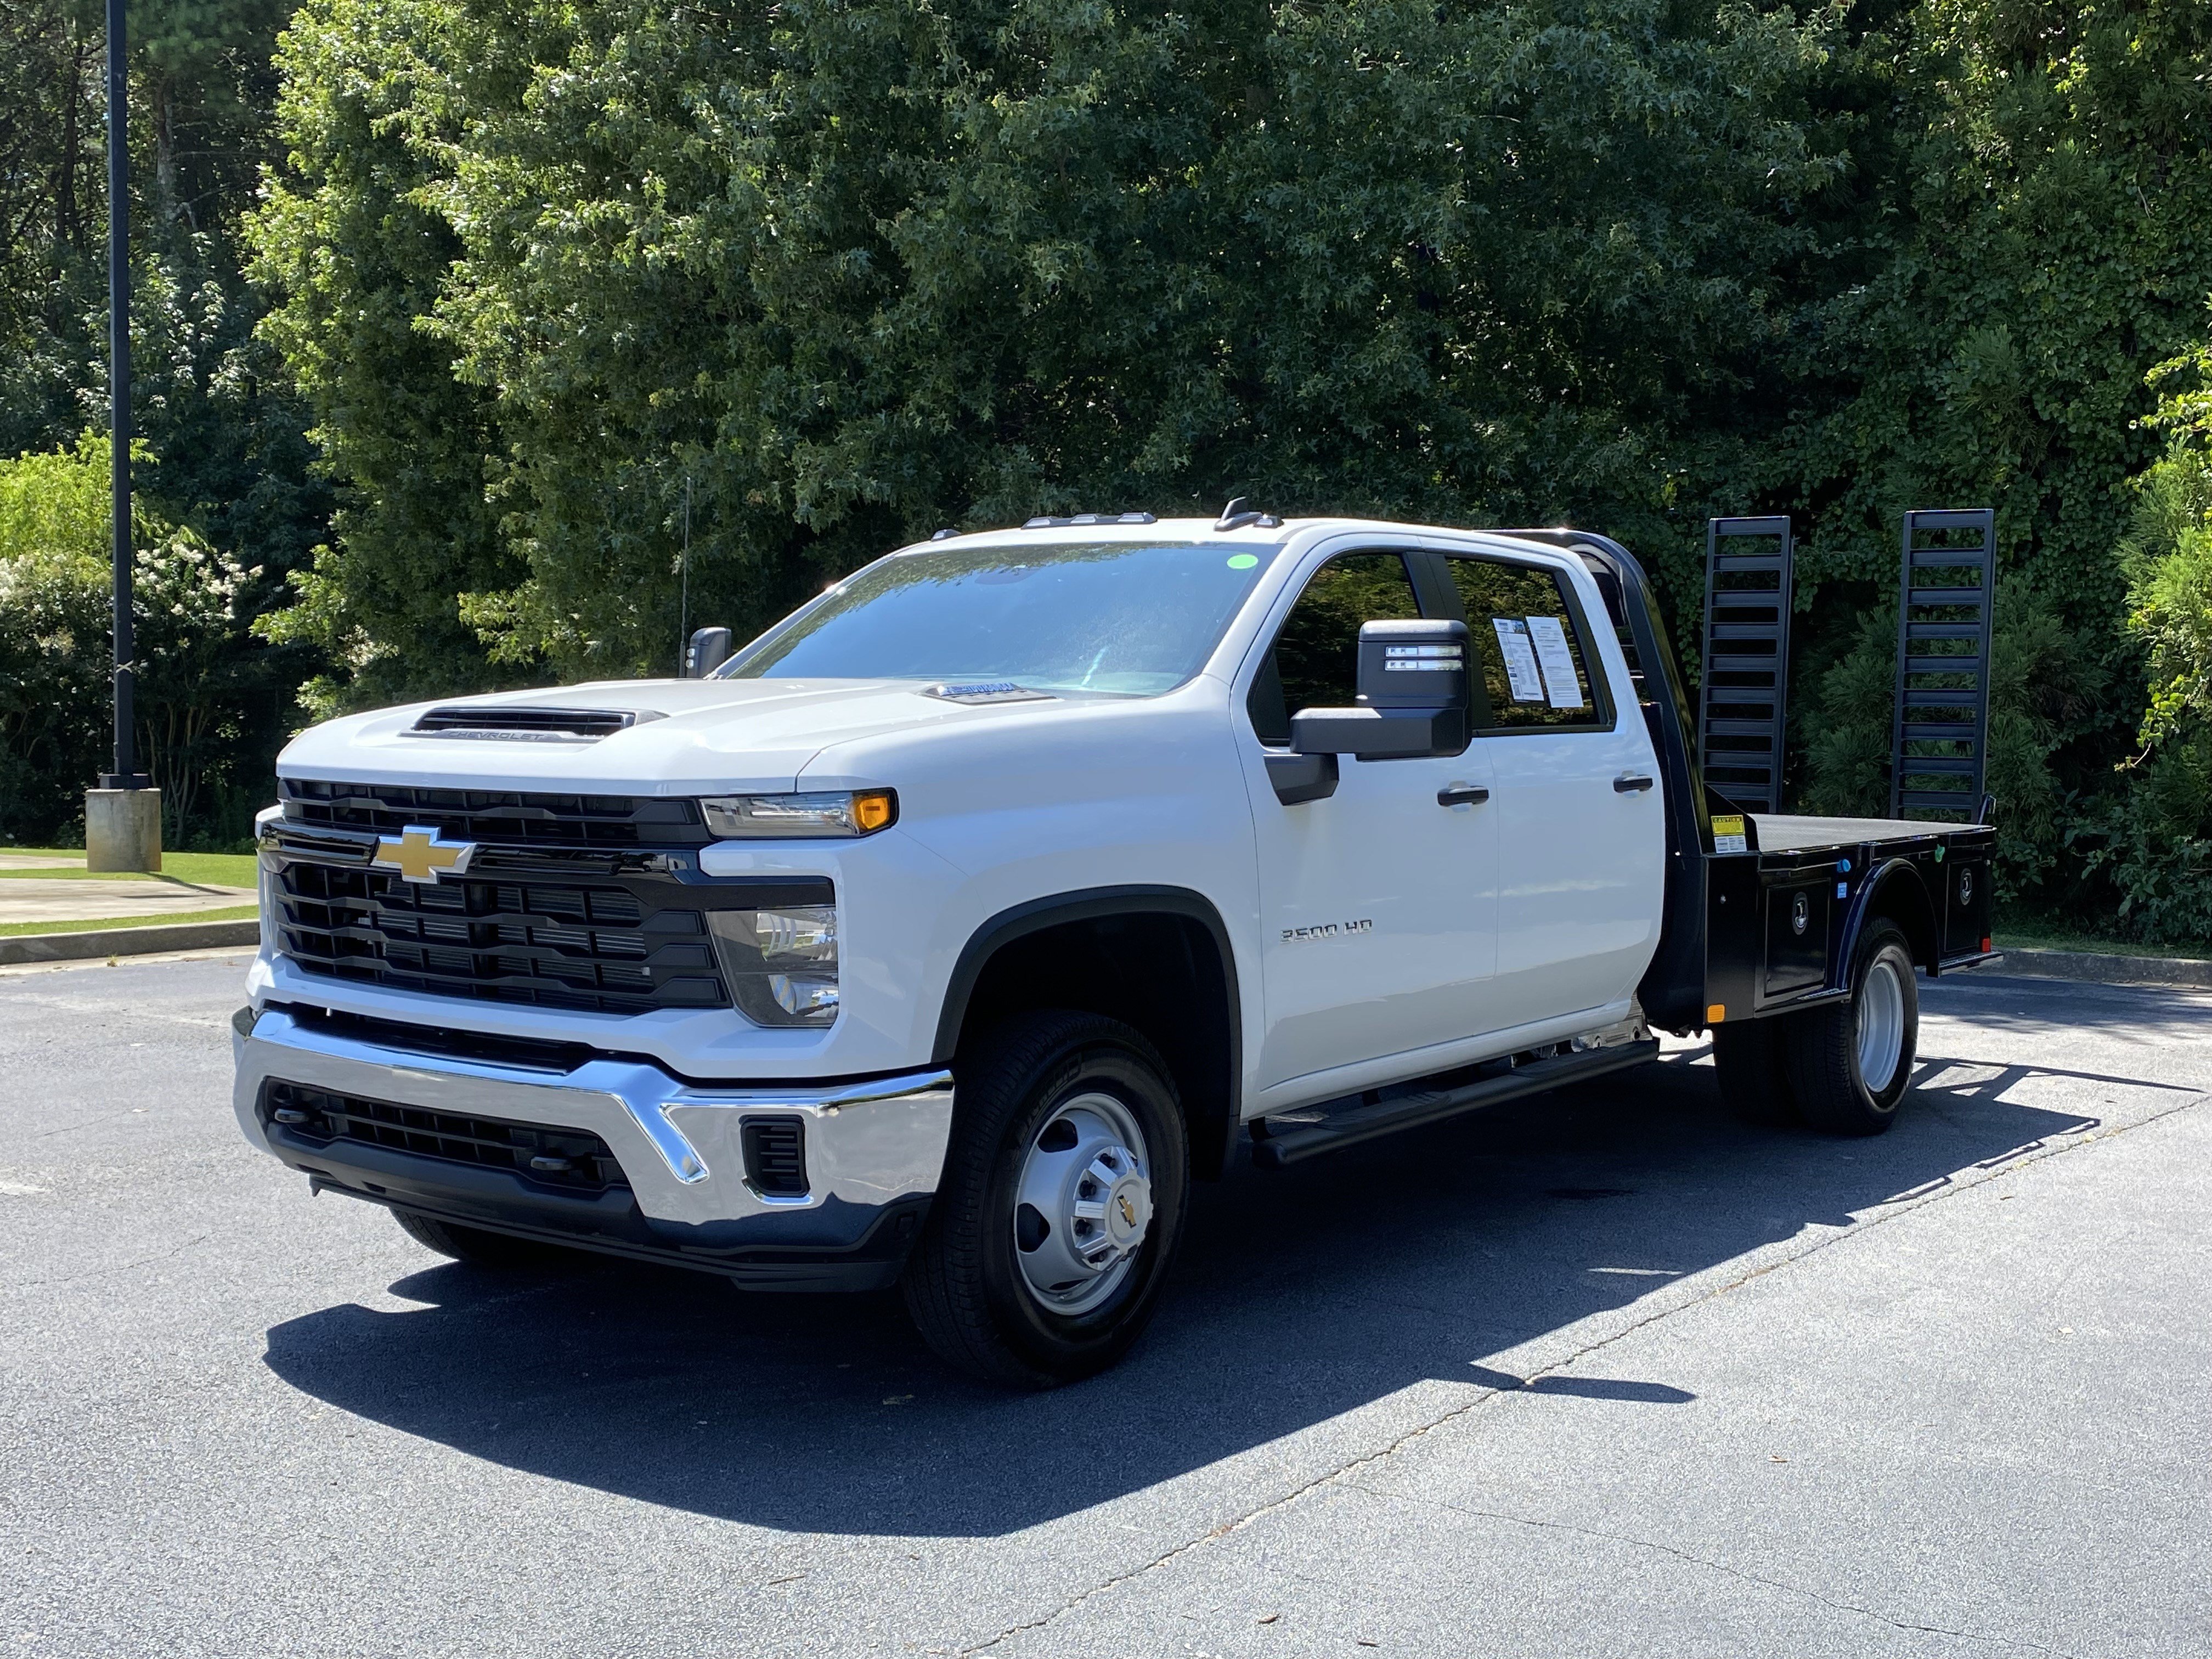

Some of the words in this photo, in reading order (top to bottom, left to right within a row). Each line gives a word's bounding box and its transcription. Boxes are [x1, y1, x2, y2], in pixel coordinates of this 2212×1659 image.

[448, 731, 544, 740] CHEVROLET
[1279, 924, 1337, 944] 3500
[1344, 919, 1372, 936] HD
